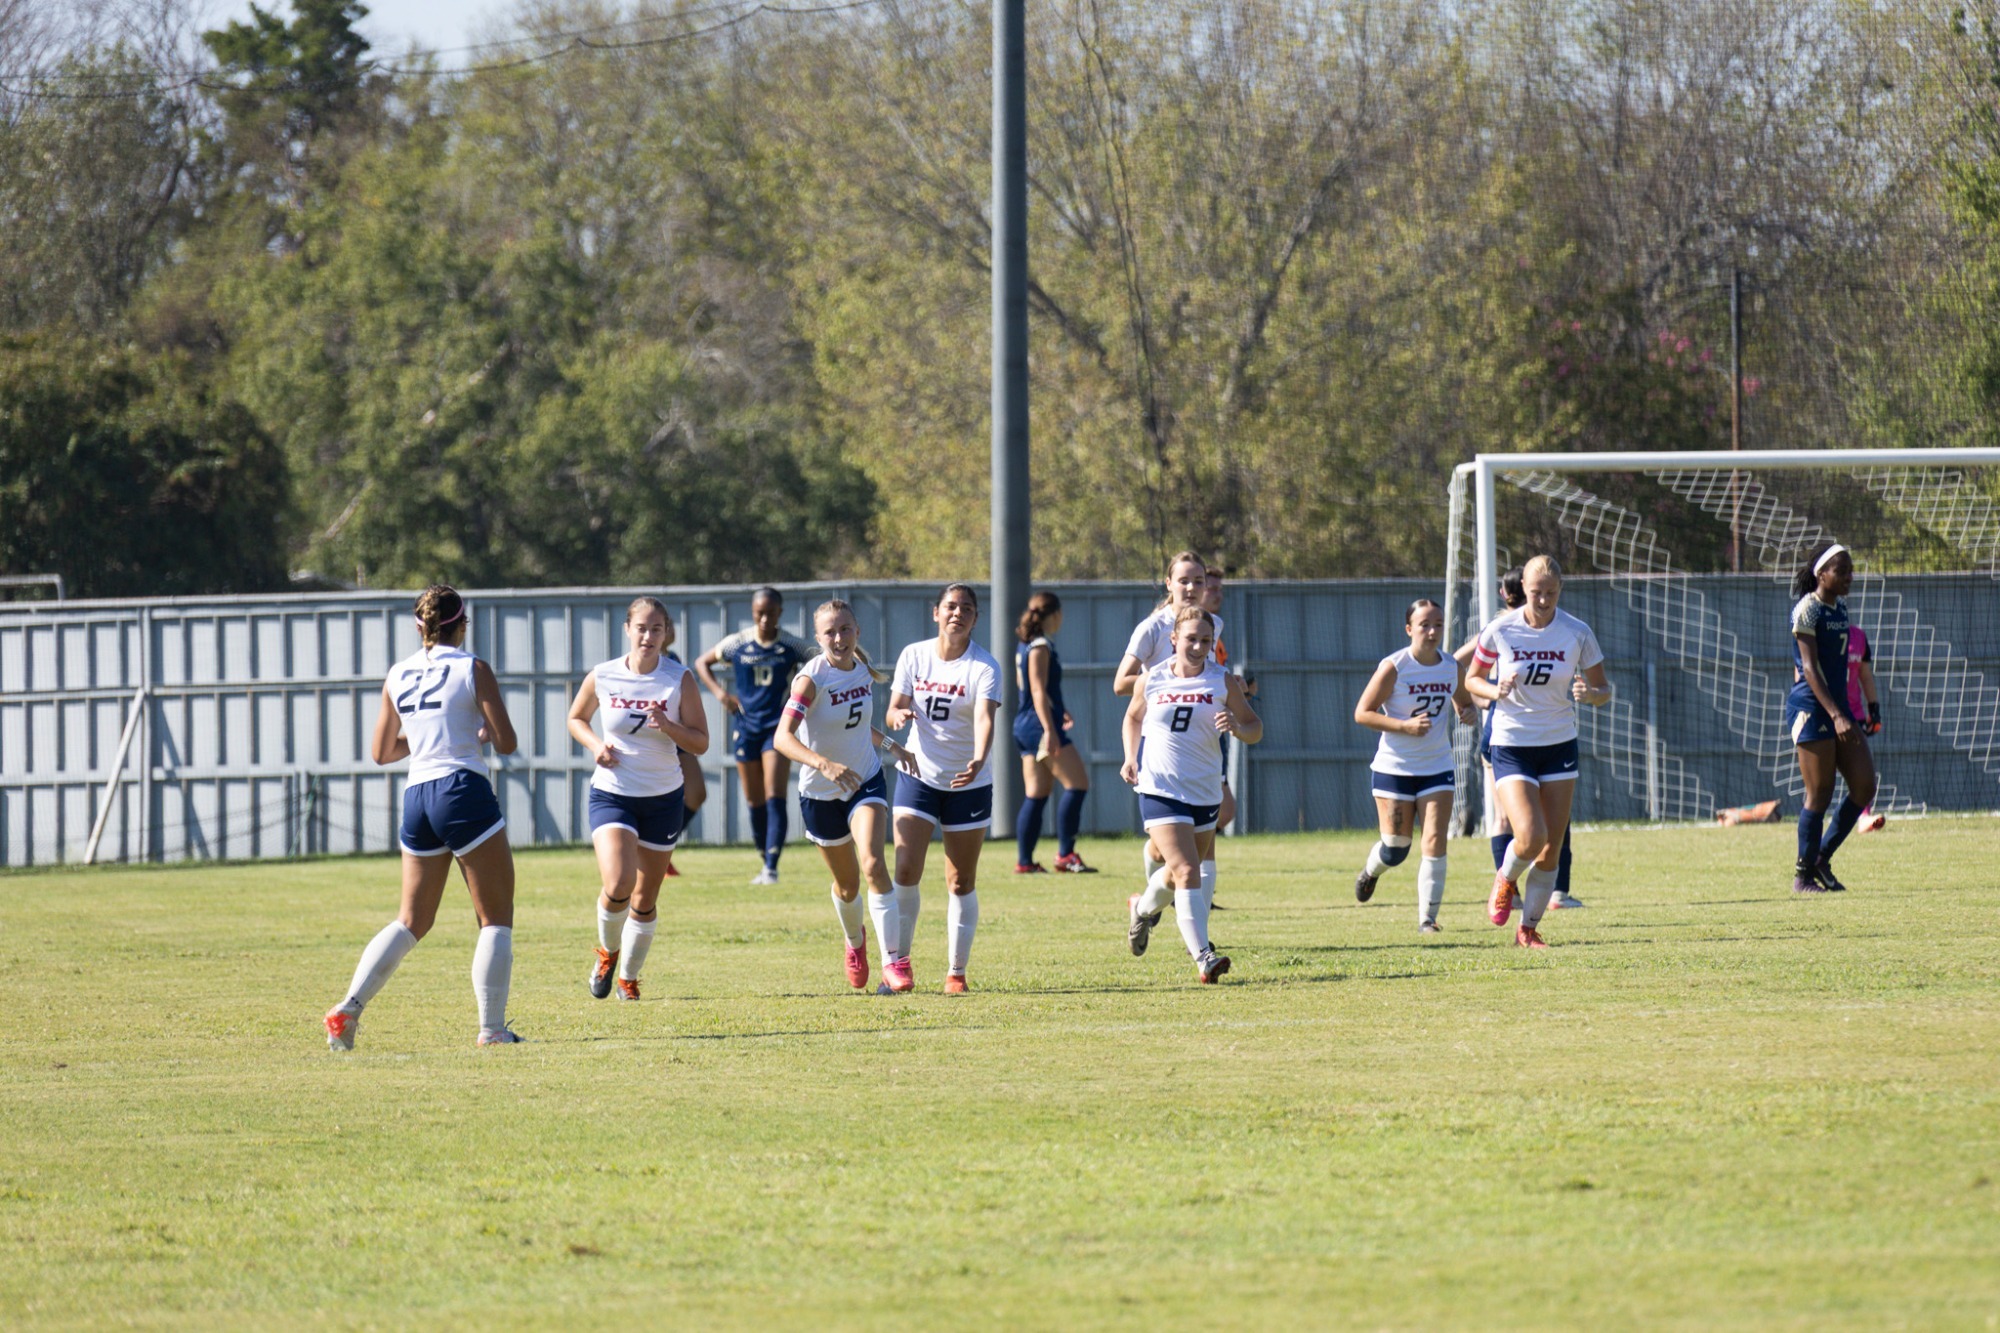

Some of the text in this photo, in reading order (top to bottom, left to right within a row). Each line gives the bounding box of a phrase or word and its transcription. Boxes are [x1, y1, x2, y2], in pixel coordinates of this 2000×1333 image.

[1840, 633, 1848, 655] 7
[1513, 650, 1565, 662] LYON
[753, 665, 773, 687] 10
[1524, 662, 1554, 686] 16
[397, 664, 451, 714] 22
[830, 684, 872, 706] LYON
[915, 677, 966, 697] LYON
[1408, 683, 1452, 695] LYON
[610, 697, 668, 711] LYON
[925, 695, 952, 721] 15
[1157, 693, 1213, 704] LYON
[1411, 695, 1446, 718] 23
[628, 713, 648, 735] 7
[845, 701, 863, 730] 5
[1171, 706, 1194, 733] 8
